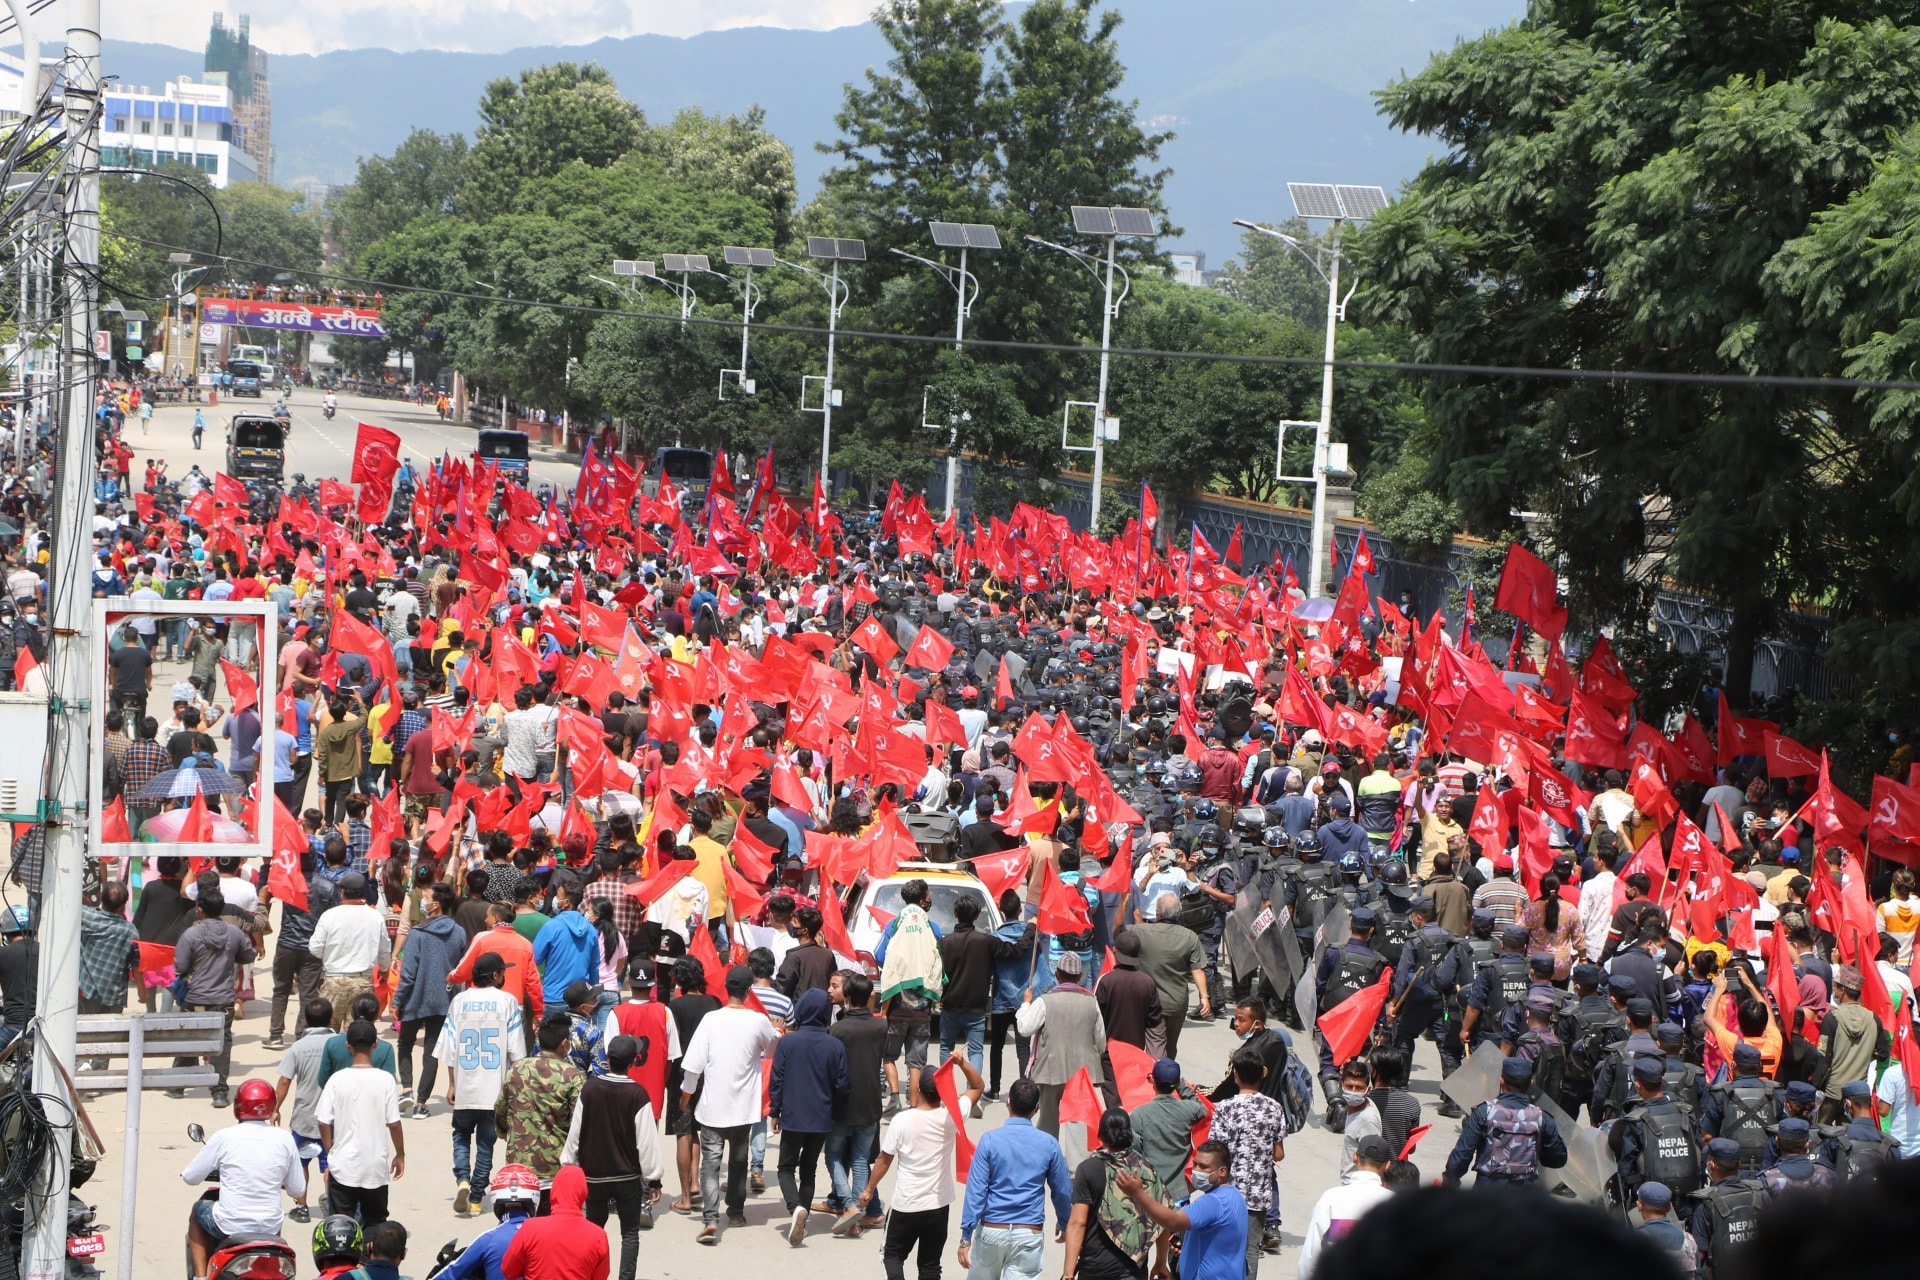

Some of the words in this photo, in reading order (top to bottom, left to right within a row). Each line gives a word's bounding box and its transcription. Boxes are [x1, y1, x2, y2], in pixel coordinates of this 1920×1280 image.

[260, 306, 313, 327] अम्बे
[1252, 910, 1274, 934] POLICE
[1503, 982, 1528, 990] NEPAL
[459, 1028, 501, 1071] 35
[1658, 1137, 1688, 1148] NEPAL
[1659, 1147, 1689, 1158] POLICE
[1728, 1219, 1759, 1232] NEPAL
[1729, 1231, 1757, 1243] POLIC
